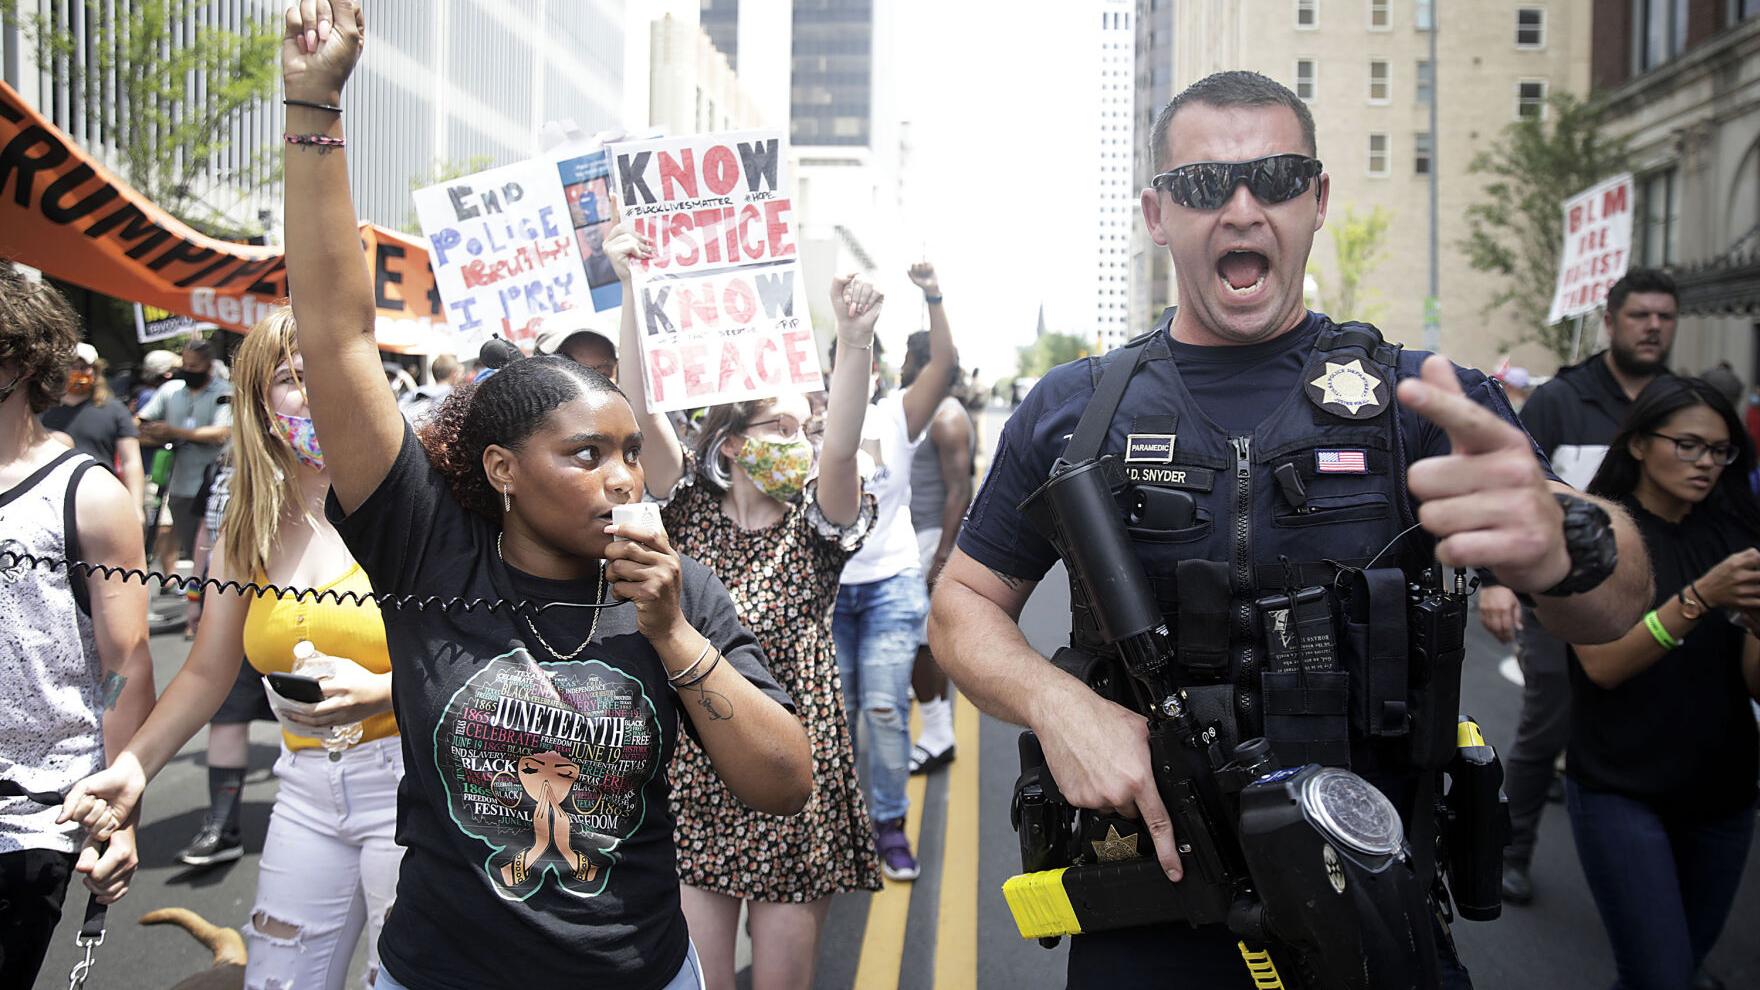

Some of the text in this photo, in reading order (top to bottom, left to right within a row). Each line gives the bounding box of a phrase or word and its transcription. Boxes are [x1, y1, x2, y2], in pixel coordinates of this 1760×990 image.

[617, 138, 779, 206] KNOW
[447, 182, 524, 222] END
[626, 197, 733, 216] #BLACKLIVESMATTER
[1569, 184, 1627, 234] BLM
[430, 206, 559, 267] POLICE
[629, 199, 796, 272] JUSTICE
[640, 271, 795, 335] KNOW
[450, 297, 482, 331] I
[650, 330, 820, 402] PEACE
[1131, 444, 1170, 452] PARAMEDIC
[1143, 469, 1187, 484] SNYDER
[501, 684, 531, 701] BLACK
[474, 698, 498, 712] 1865
[597, 701, 620, 710] FREE
[462, 707, 490, 724] 1865
[490, 695, 626, 748] JUNETEENTH
[455, 720, 466, 735] TEXAS
[465, 722, 539, 748] CELEBRATE
[452, 735, 483, 750] JUNE 19
[484, 741, 506, 752] 1865
[541, 735, 573, 747] FREEDOM
[631, 735, 651, 745] FREE
[451, 746, 467, 758] END
[468, 748, 506, 759] SLAVERY
[507, 745, 533, 755] BLACK
[569, 742, 621, 763] JUNE 19
[461, 758, 518, 772] BLACK
[571, 758, 617, 771] JUNETEENTH
[581, 765, 605, 778] FREE
[619, 759, 647, 772] TEXAS
[579, 774, 600, 785] TEXAS
[463, 783, 492, 796] 1865
[464, 793, 498, 804] FREEDOM
[474, 802, 533, 822] FESTIVAL
